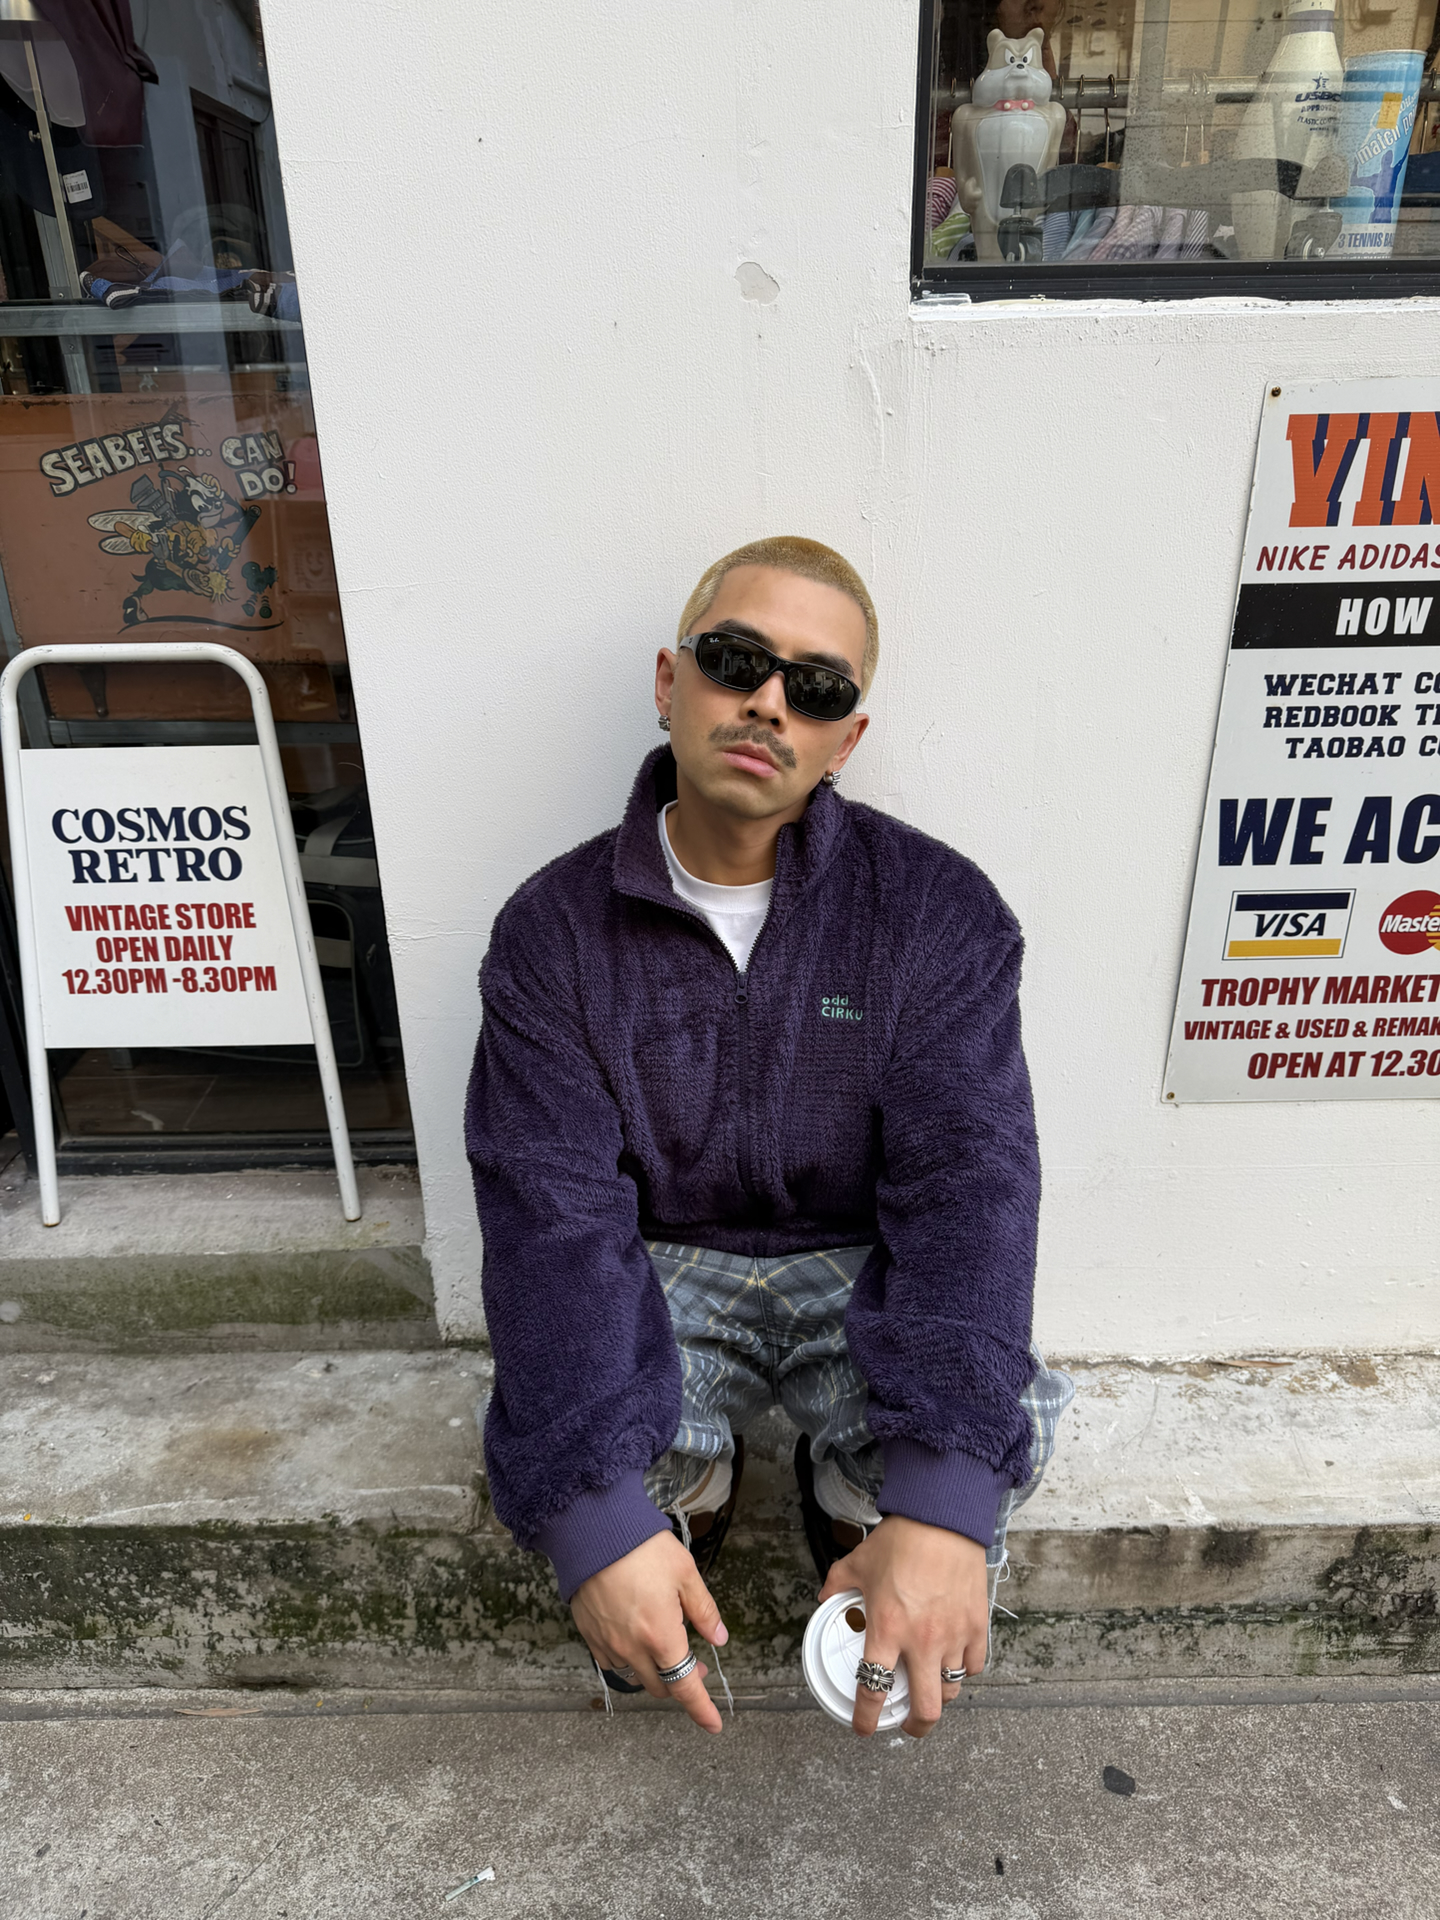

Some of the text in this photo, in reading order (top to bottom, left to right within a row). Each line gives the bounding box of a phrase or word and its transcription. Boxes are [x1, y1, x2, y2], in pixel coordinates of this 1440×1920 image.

[1338, 233, 1346, 248] 3
[1347, 232, 1384, 248] TENNIS
[219, 429, 285, 469] CAN
[235, 460, 298, 500] DO!
[1256, 545, 1330, 571] NIKE
[1335, 597, 1434, 636] HOW
[1264, 672, 1402, 696] WECHAT
[1262, 704, 1402, 728] REDBOOK
[1285, 735, 1440, 759] TAOBAO C
[51, 805, 251, 844] COSMOS
[1218, 793, 1440, 867] WE AC
[67, 847, 243, 884] RETRO
[64, 902, 257, 932] VINTAGE STORE
[1254, 912, 1327, 938] VISA
[95, 935, 233, 963] OPEN DAILY
[822, 994, 849, 1006] odd
[1201, 974, 1440, 1007] TROPHY MARKET
[1184, 1020, 1273, 1041] VINTAGE
[1275, 1022, 1290, 1039] &
[1295, 1018, 1350, 1039] USED
[1352, 1021, 1368, 1038] &
[1247, 1052, 1323, 1080] OPEN
[1324, 1050, 1367, 1079] AT
